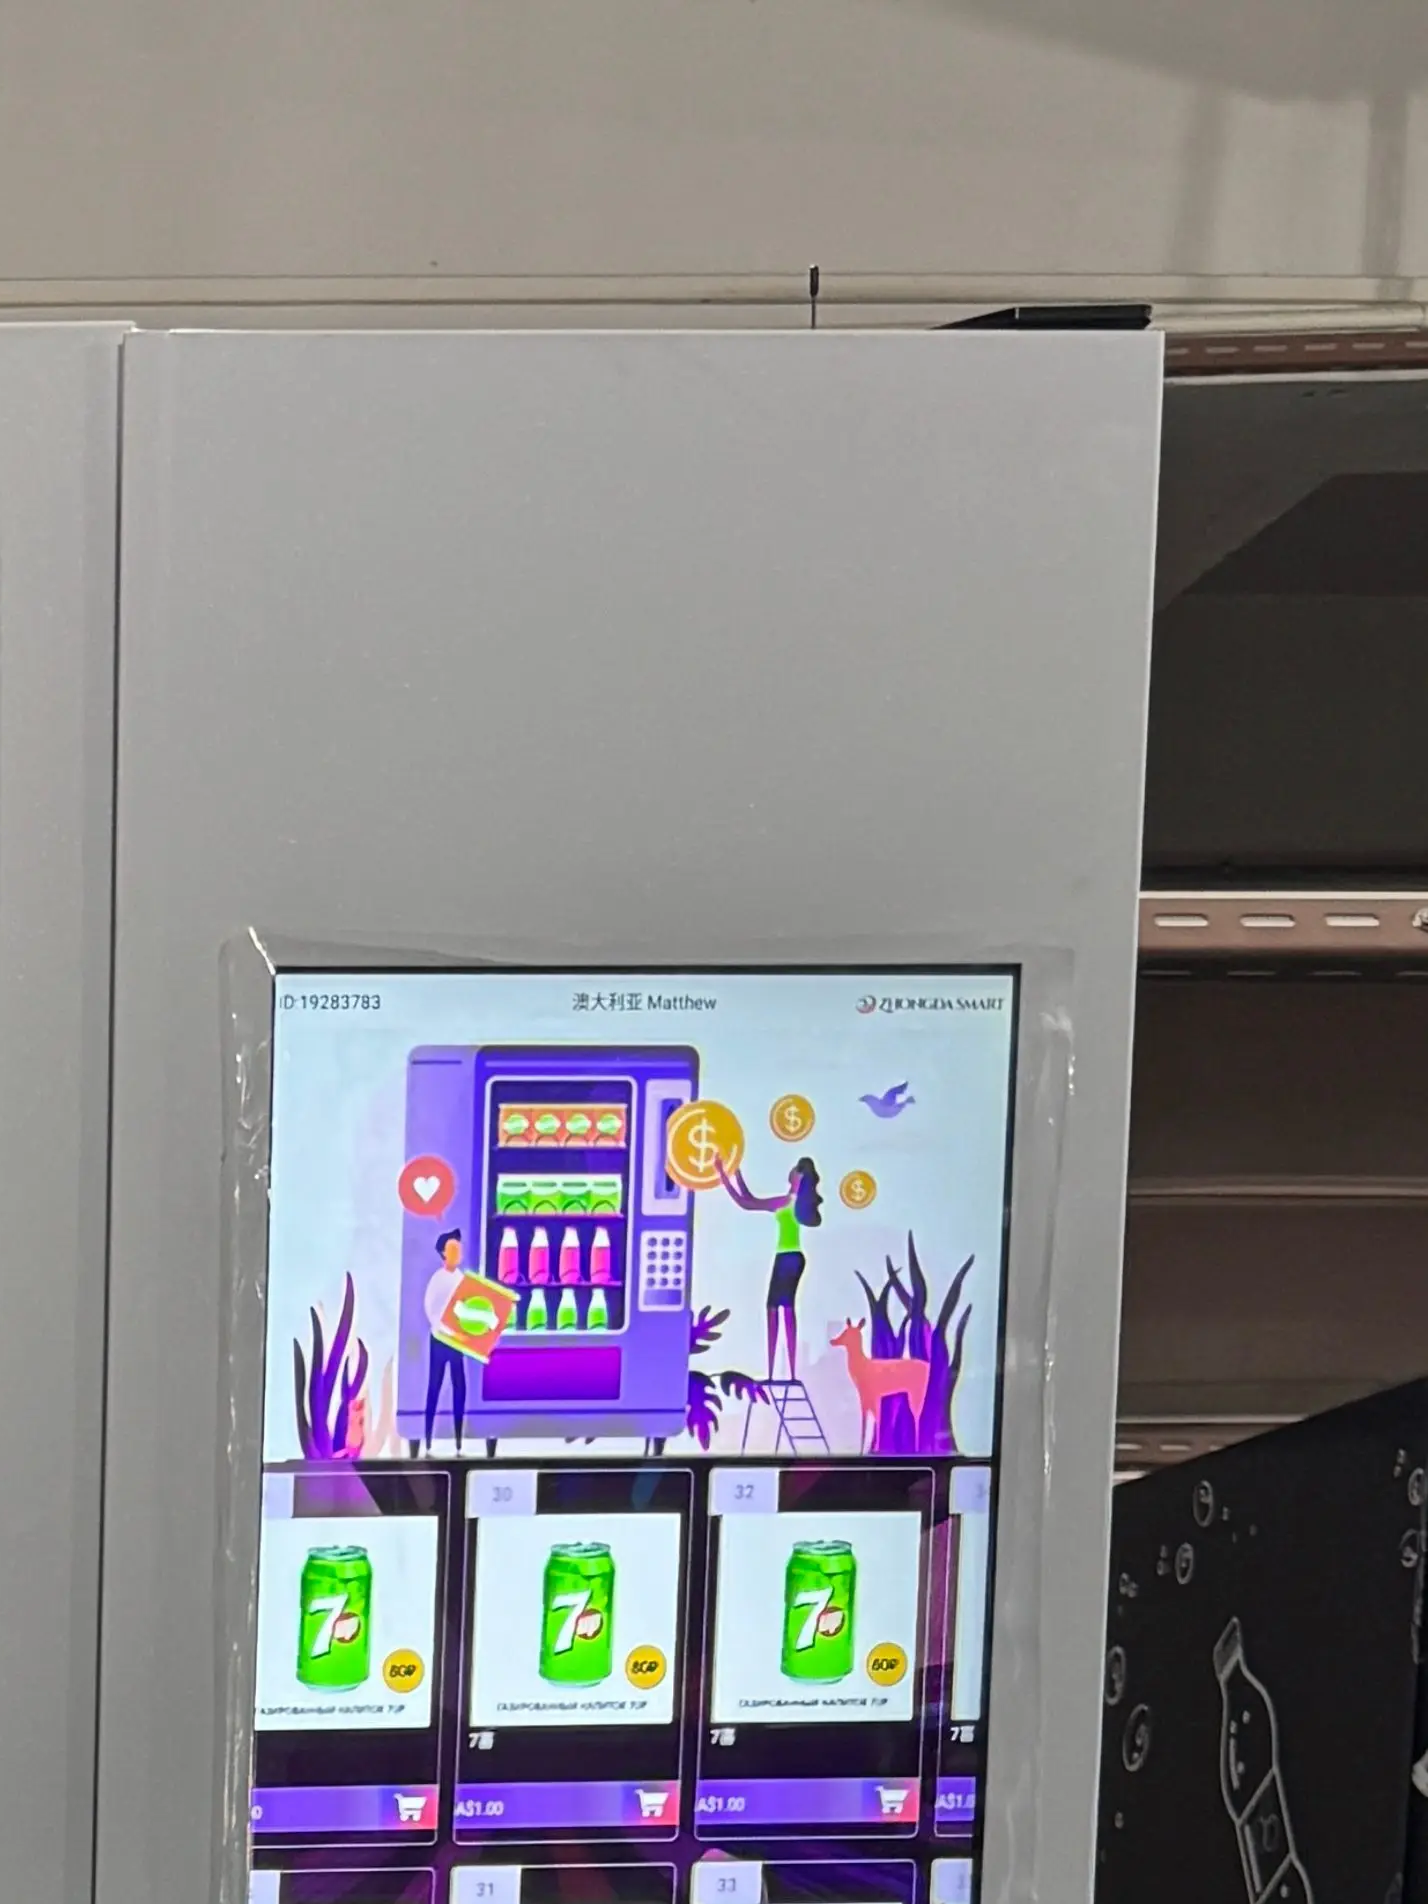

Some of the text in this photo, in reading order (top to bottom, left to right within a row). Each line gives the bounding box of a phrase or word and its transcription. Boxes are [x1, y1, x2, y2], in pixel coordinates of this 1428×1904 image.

[573, 992, 717, 1011] 澳大利亚 Matthew
[879, 997, 1004, 1012] ZHONGDA SMART
[734, 1484, 755, 1500] 32
[476, 1881, 495, 1897] 31
